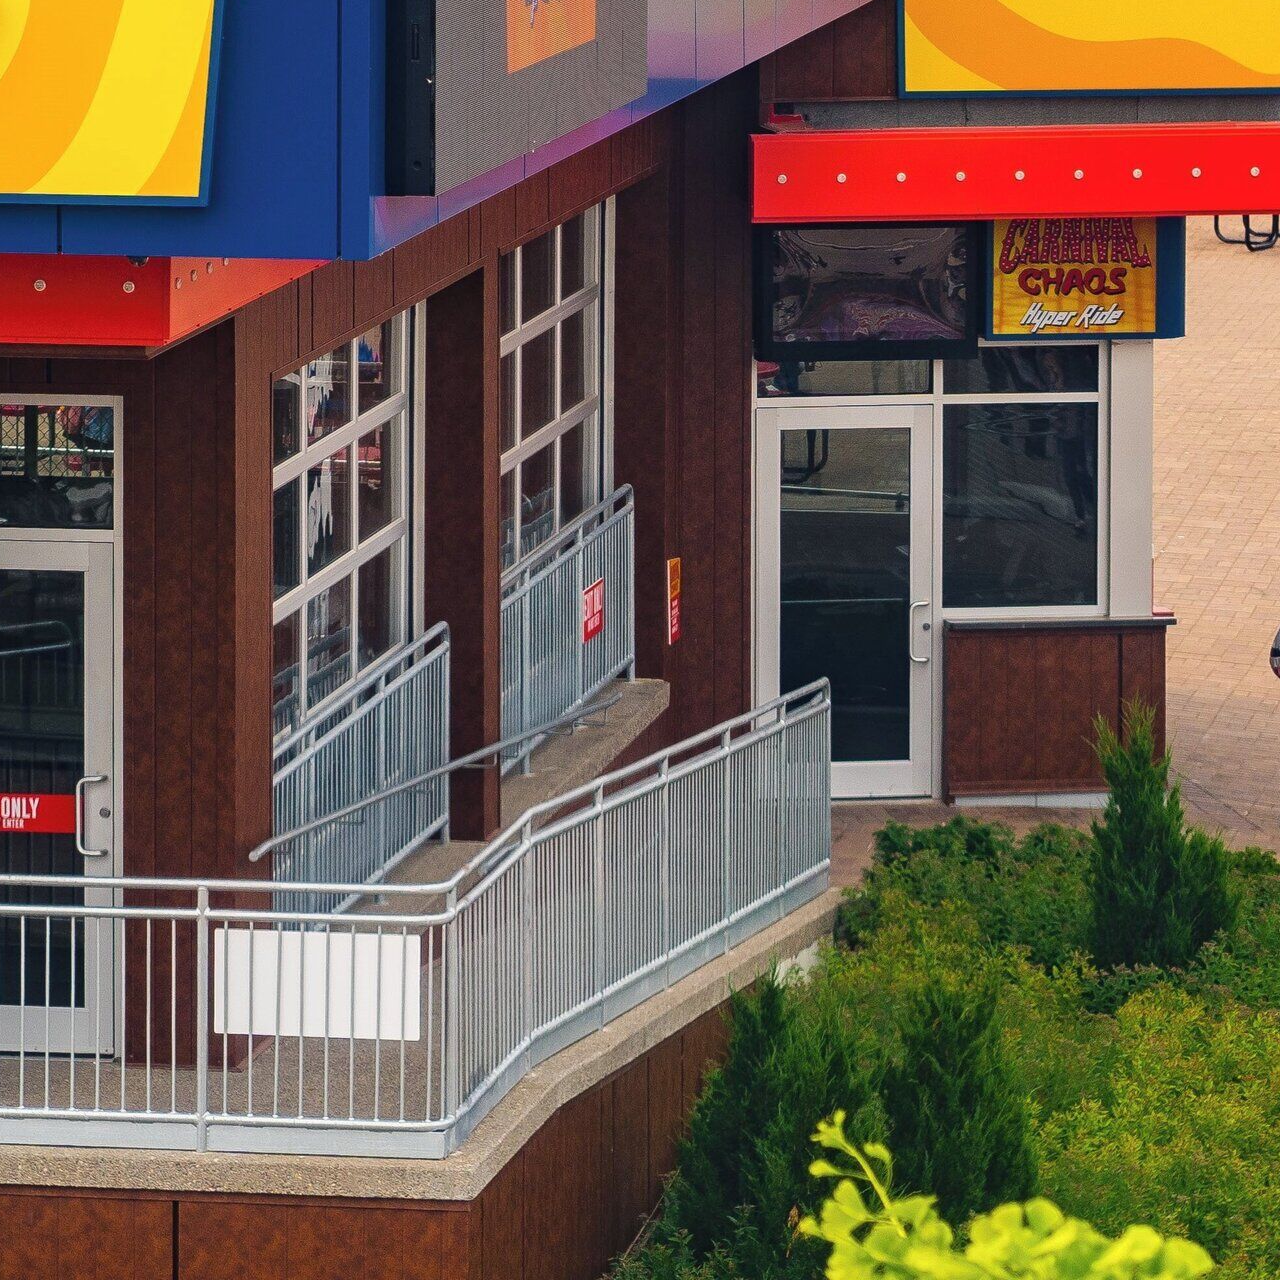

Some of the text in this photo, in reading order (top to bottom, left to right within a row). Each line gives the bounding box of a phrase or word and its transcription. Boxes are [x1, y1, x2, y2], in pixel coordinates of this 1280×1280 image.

[998, 217, 1153, 275] CARNIVAL
[1018, 267, 1128, 296] CHAOS
[1020, 302, 1125, 334] Hyper Ride
[0, 796, 40, 819] ONLY
[2, 818, 25, 829] ENTER
